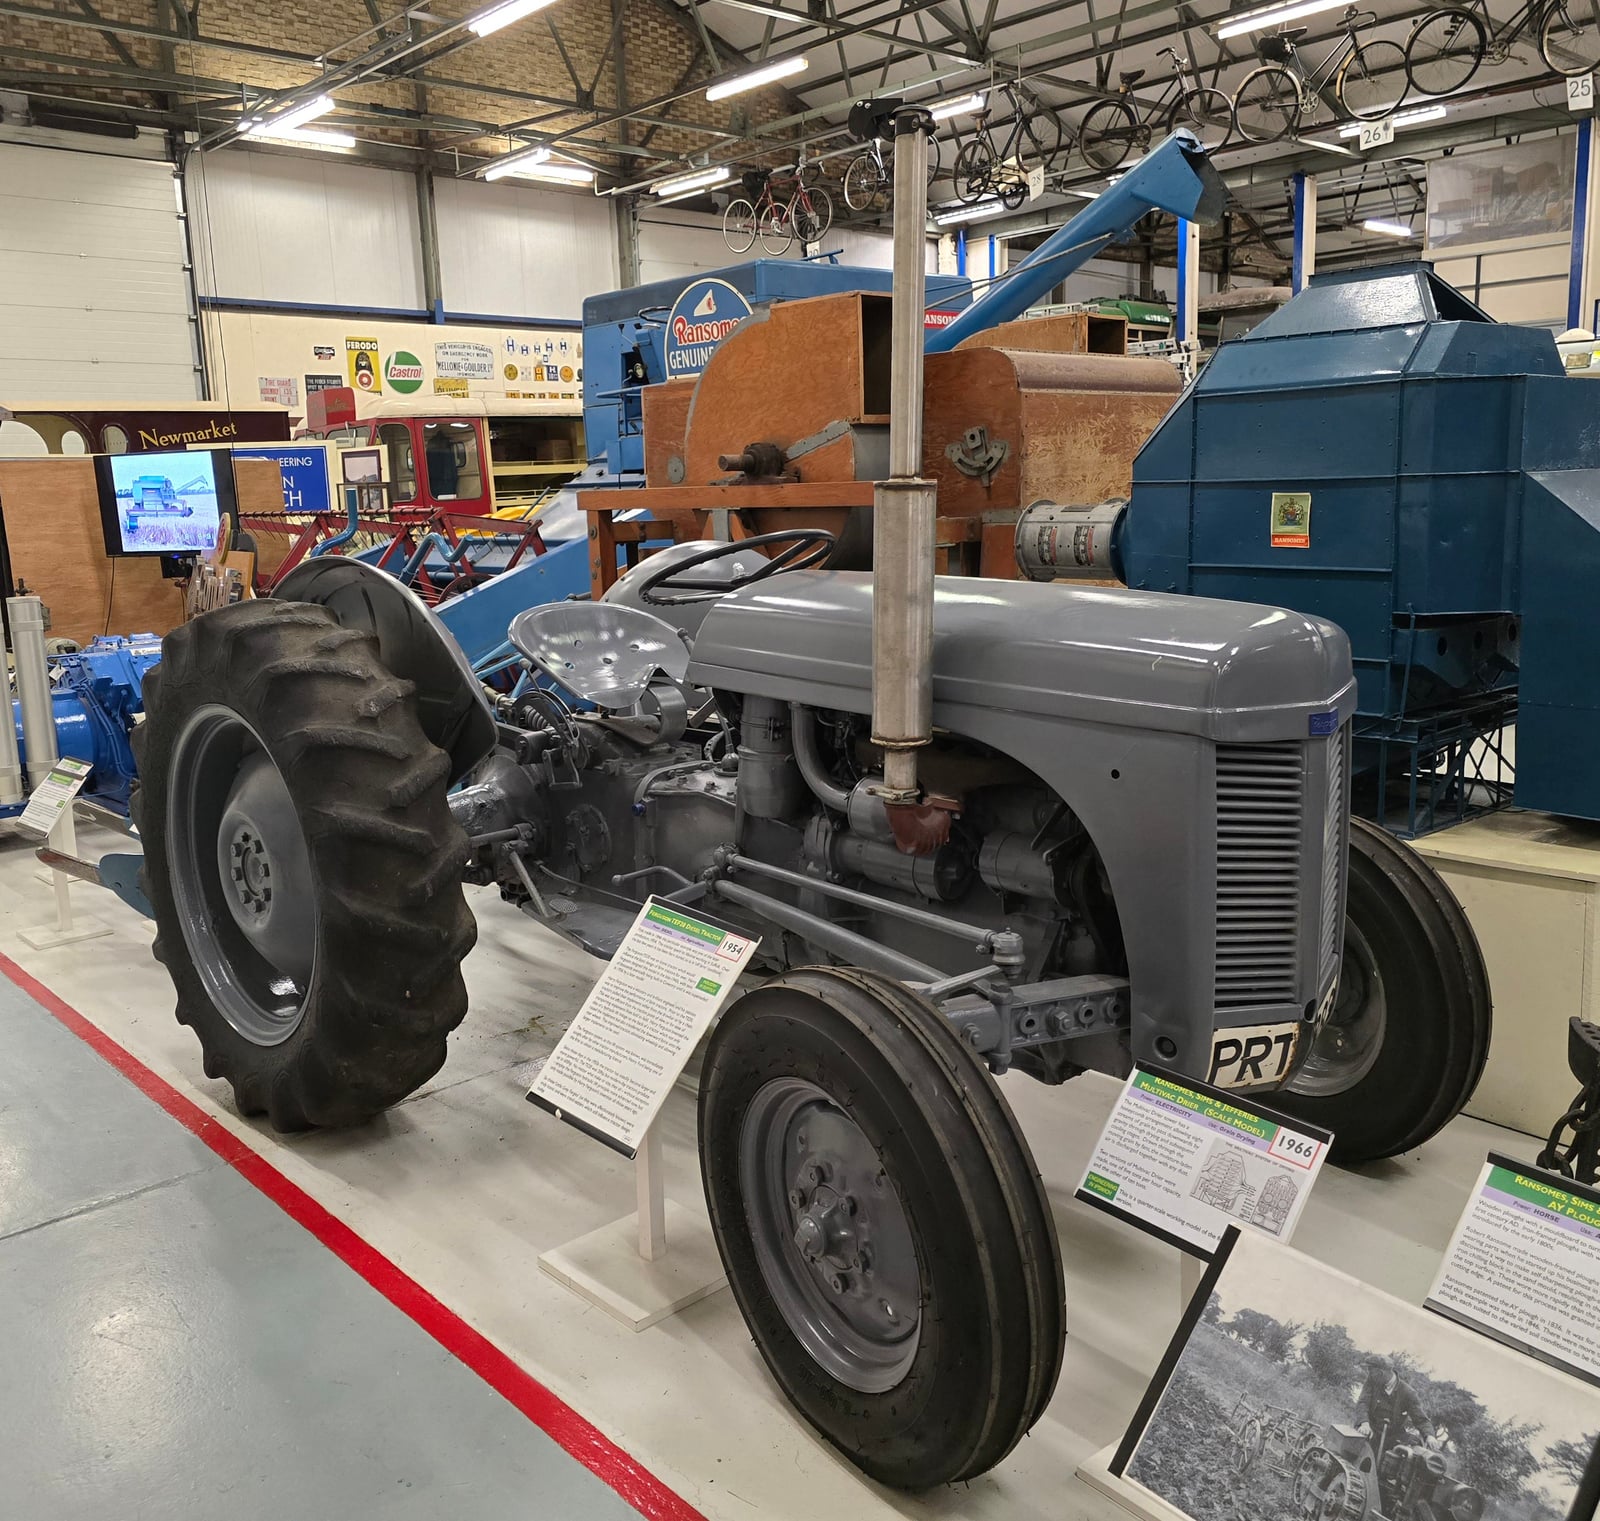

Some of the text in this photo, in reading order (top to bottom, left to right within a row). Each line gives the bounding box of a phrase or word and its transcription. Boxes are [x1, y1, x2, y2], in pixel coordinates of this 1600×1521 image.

[1570, 79, 1590, 98] 25
[1364, 129, 1382, 144] 26
[673, 316, 746, 346] Ransom
[924, 314, 957, 325] ANSOM
[346, 341, 378, 350] FERODO
[506, 339, 514, 352] H
[521, 346, 528, 354] H
[546, 342, 553, 352] H
[560, 342, 567, 350] H
[389, 366, 422, 378] Castrol
[138, 420, 237, 449] Newmarket
[271, 457, 312, 466] EERING
[722, 941, 743, 954] 1954
[1208, 1032, 1294, 1085] PRT
[1140, 1081, 1264, 1137] MULTIVAC DRIER (SCALE MODEL)
[1154, 1077, 1193, 1097] RANSOMES,
[1196, 1093, 1213, 1104] SIMS
[1222, 1104, 1258, 1122] JEFFERIES
[1155, 1100, 1192, 1117] ELECTRICITY
[1219, 1126, 1235, 1135] Grain
[1236, 1132, 1255, 1144] Drying
[1278, 1135, 1312, 1157] 1966
[1150, 1179, 1162, 1188] hour
[1515, 1175, 1593, 1210] RANSOMES, SIMS
[1119, 1188, 1128, 1197] This
[1166, 1212, 1185, 1225] working
[1185, 1222, 1201, 1231] model
[1478, 1199, 1501, 1212] Wooden
[1502, 1210, 1524, 1221] ploughs
[1543, 1227, 1579, 1243] mouldboard
[1512, 1200, 1559, 1222] Power: HORSE
[1547, 1201, 1564, 1211] AY
[1566, 1207, 1600, 1226] PLOUG
[1486, 1212, 1508, 1223] century
[1522, 1225, 1556, 1242] Iron-framed
[1556, 1240, 1578, 1252] ploughs
[1450, 1261, 1469, 1273] cutting
[1492, 1280, 1511, 1290] patent
[1522, 1292, 1532, 1300] this
[1533, 1298, 1556, 1310] process
[1570, 1314, 1594, 1327] granted
[1488, 1259, 1504, 1270] block
[1522, 1276, 1536, 1284] sand
[1558, 1291, 1583, 1306] resulting
[1498, 1272, 1514, 1283] These
[1516, 1282, 1531, 1290] wore
[1532, 1288, 1548, 1298] more
[1549, 1296, 1569, 1308] rapidly
[1570, 1305, 1584, 1314] than
[1445, 1274, 1472, 1290] Ransomes
[1472, 1288, 1498, 1302] patented
[1518, 1308, 1538, 1320] plough
[1459, 1299, 1472, 1307] each
[1473, 1305, 1490, 1315] suited
[1510, 1322, 1528, 1333] varied
[1540, 1336, 1571, 1353] conditions
[1464, 1293, 1487, 1305] example
[1500, 1309, 1516, 1318] made
[1543, 1326, 1560, 1338] There
[1562, 1337, 1577, 1346] were
[1578, 1344, 1595, 1354] more
